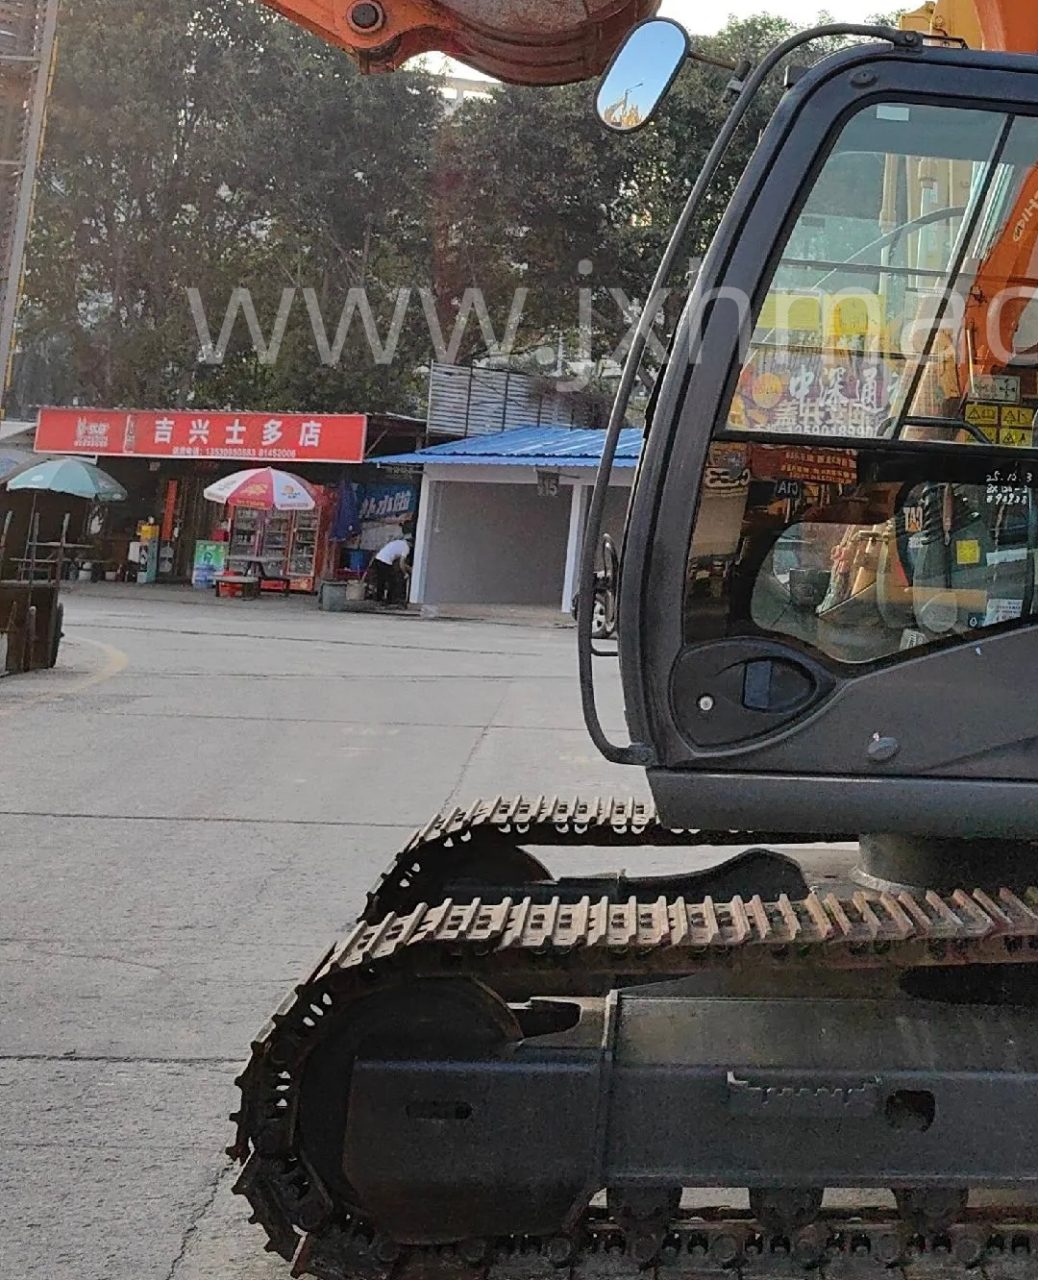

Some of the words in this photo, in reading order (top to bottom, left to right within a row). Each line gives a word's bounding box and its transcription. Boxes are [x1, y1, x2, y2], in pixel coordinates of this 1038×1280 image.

[154, 417, 322, 448] 吉兴士多店
